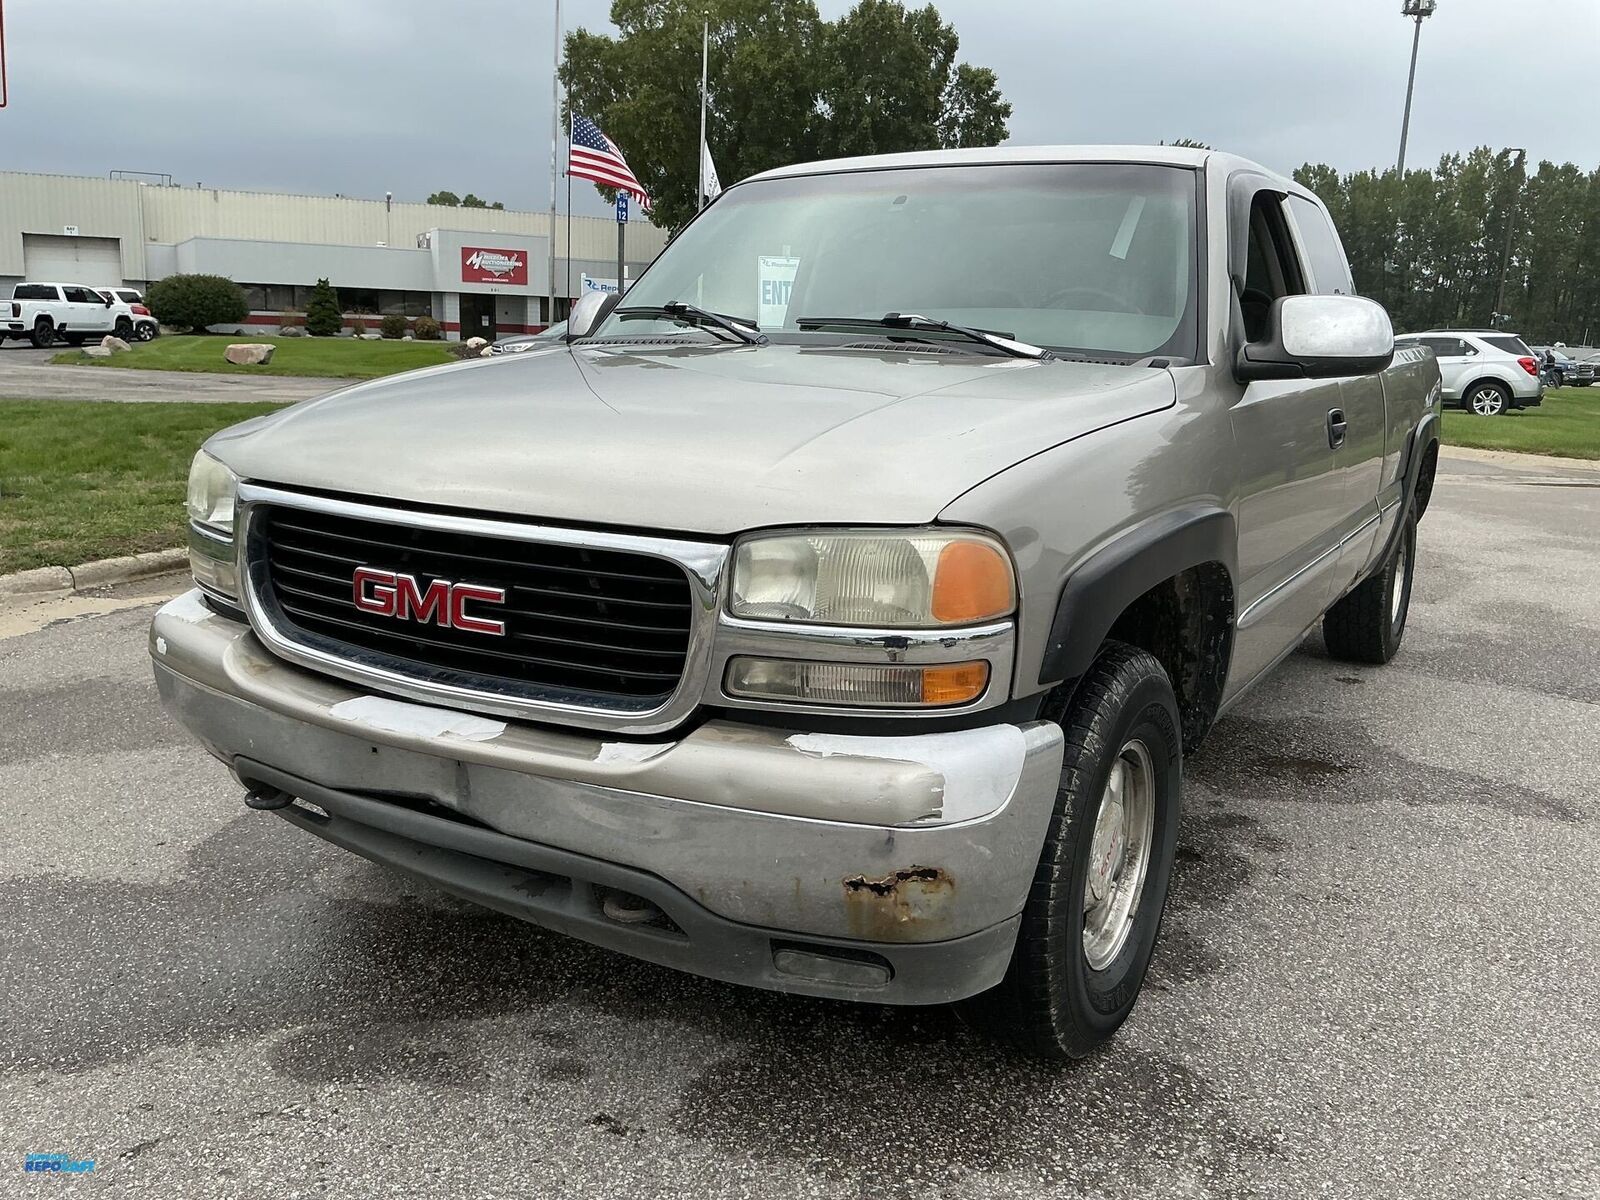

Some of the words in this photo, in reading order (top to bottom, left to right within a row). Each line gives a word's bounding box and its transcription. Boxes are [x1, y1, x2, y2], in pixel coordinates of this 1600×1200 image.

[618, 201, 627, 209] 56
[618, 211, 627, 220] 12
[762, 280, 794, 305] ENT
[353, 566, 506, 637] GMC
